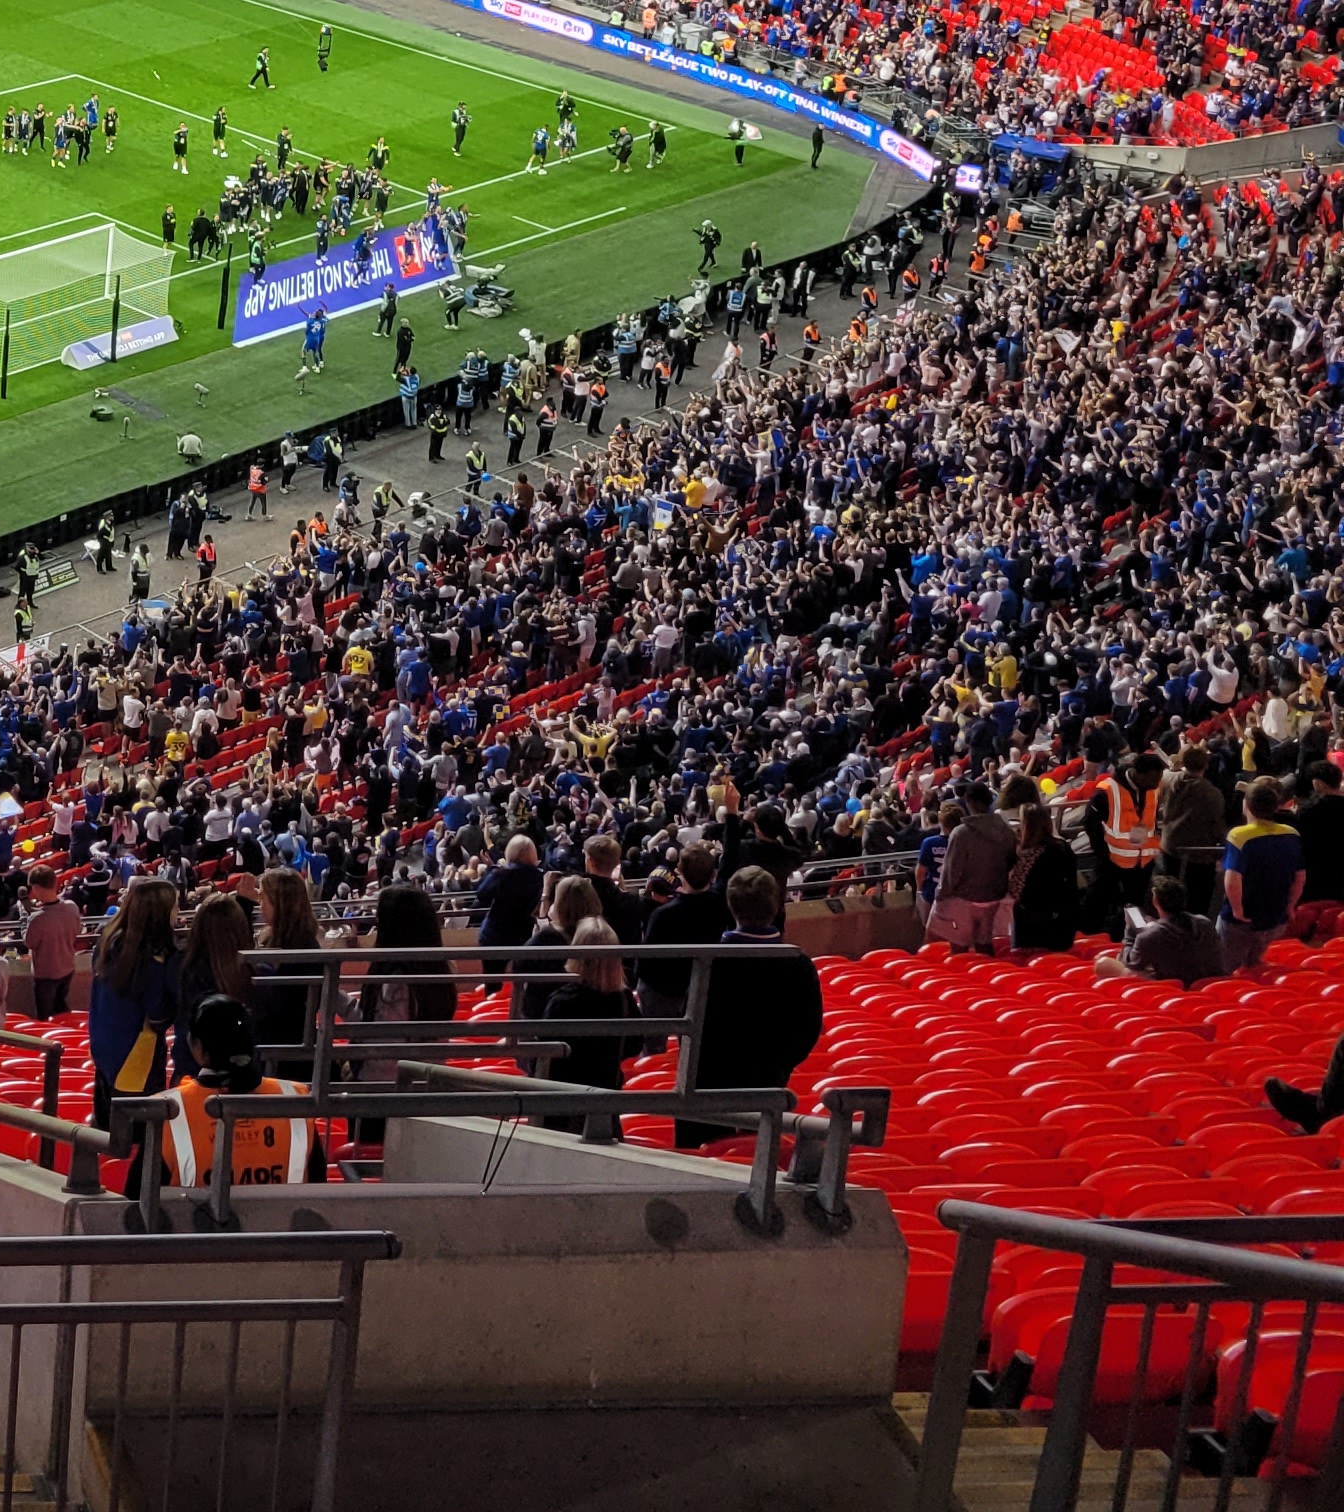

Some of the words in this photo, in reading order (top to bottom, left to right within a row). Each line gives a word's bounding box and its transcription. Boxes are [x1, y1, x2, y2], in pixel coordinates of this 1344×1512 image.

[573, 26, 585, 36] EFL
[602, 33, 626, 47] SKY
[628, 41, 652, 55] BET
[652, 47, 699, 71] LEAGUE
[700, 63, 727, 83] TWO
[728, 71, 786, 101] PLAY-OFF
[787, 92, 819, 115] FINAL
[820, 104, 872, 137] WINNERS
[244, 285, 268, 319] APP
[269, 268, 315, 311] BETTING
[263, 1125, 275, 1148] 8
